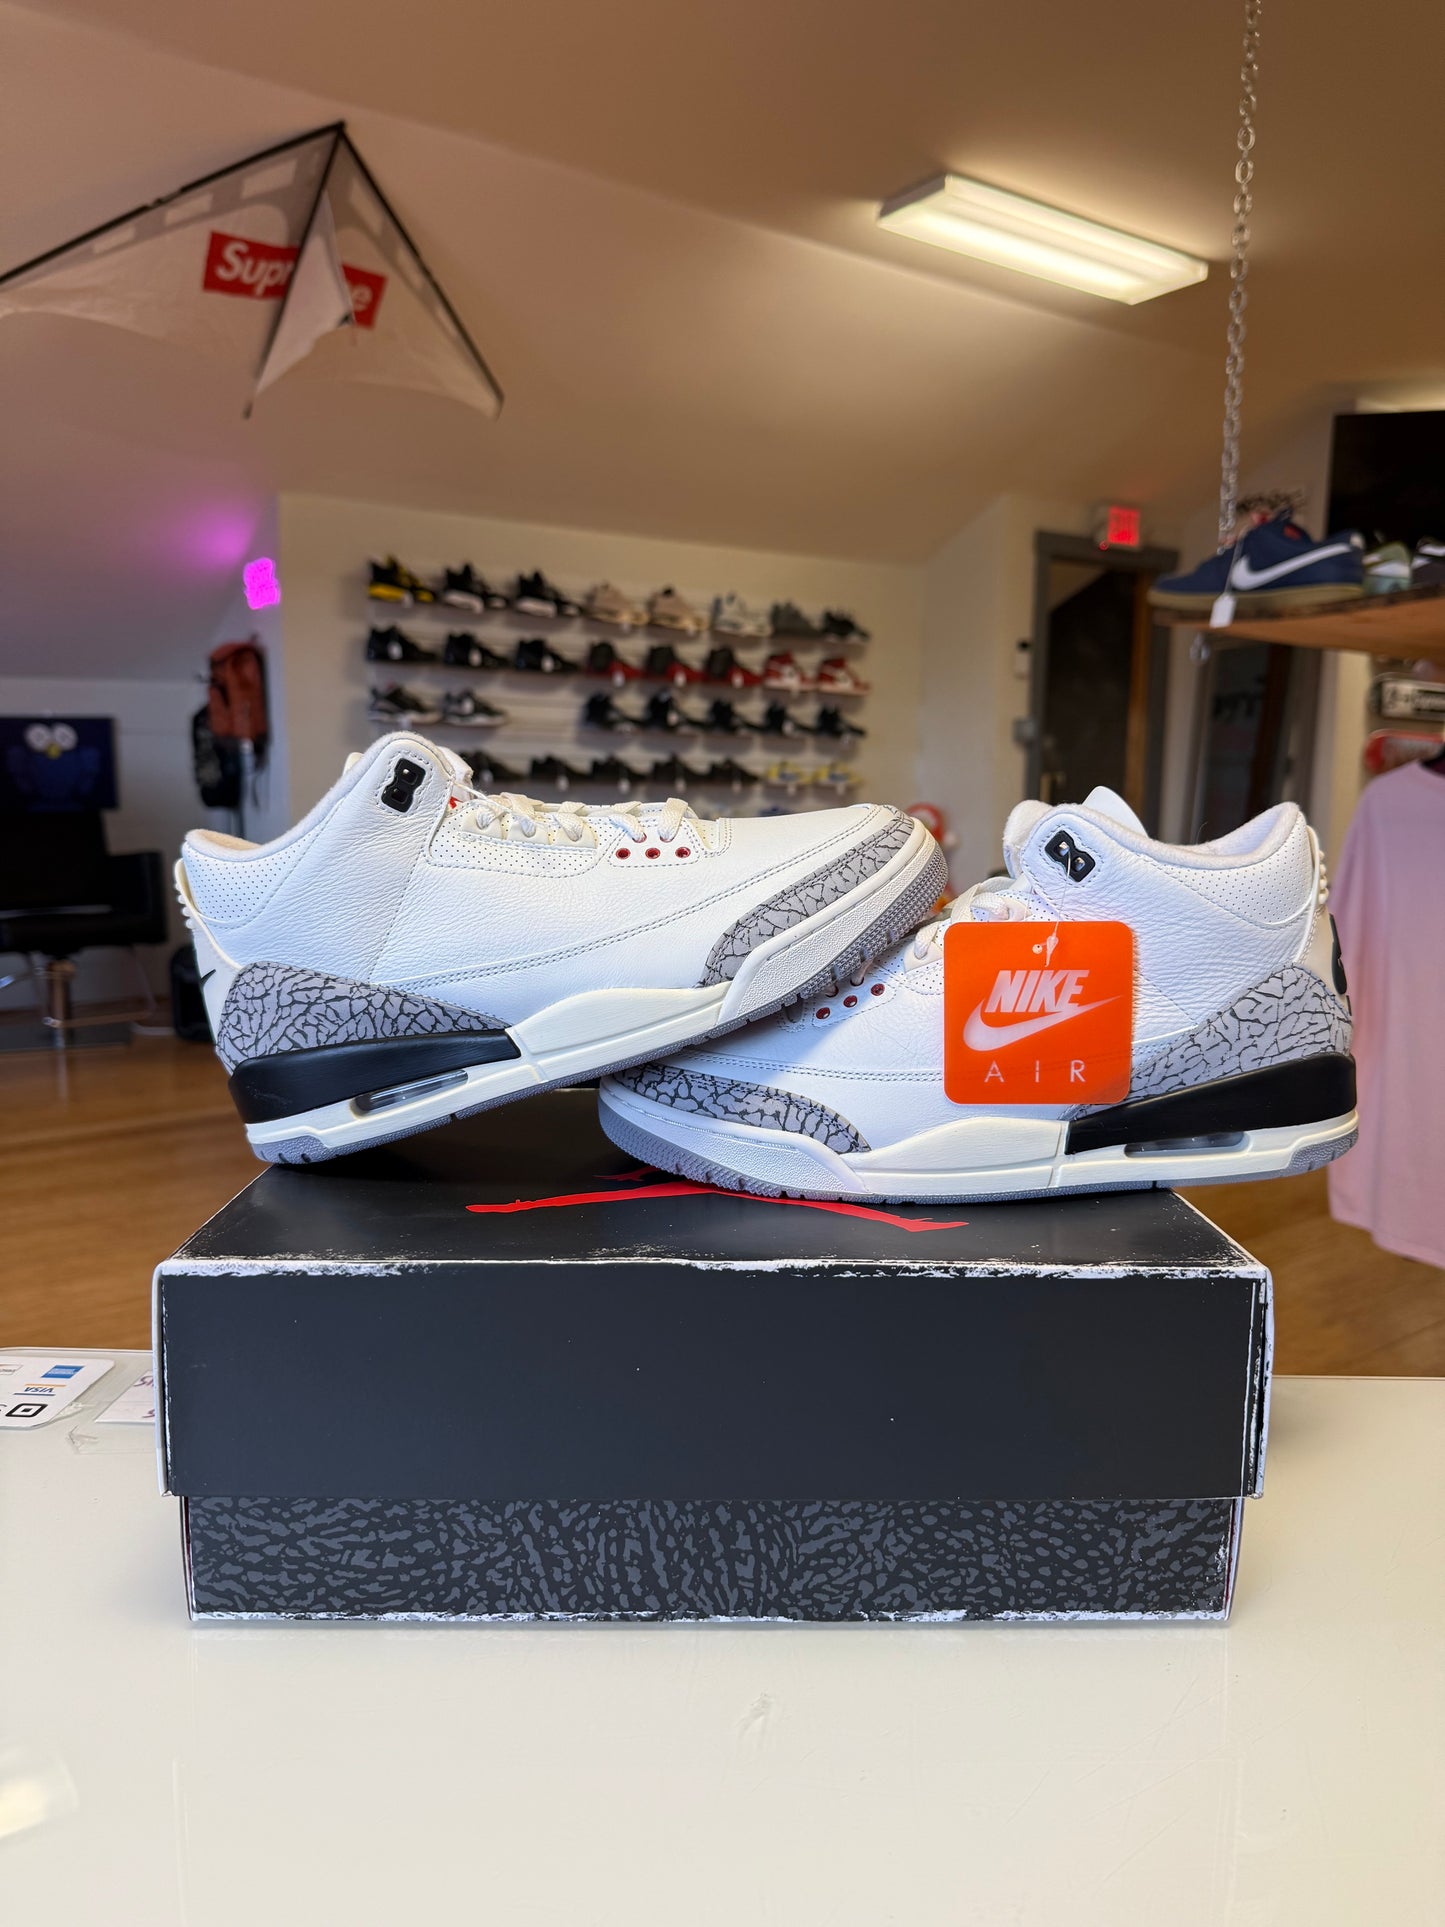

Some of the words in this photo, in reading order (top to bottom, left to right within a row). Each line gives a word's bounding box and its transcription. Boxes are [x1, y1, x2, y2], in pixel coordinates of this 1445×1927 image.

[215, 239, 374, 313] Supre
[984, 969, 1090, 1013] NIKE
[984, 1059, 1086, 1083] AIR
